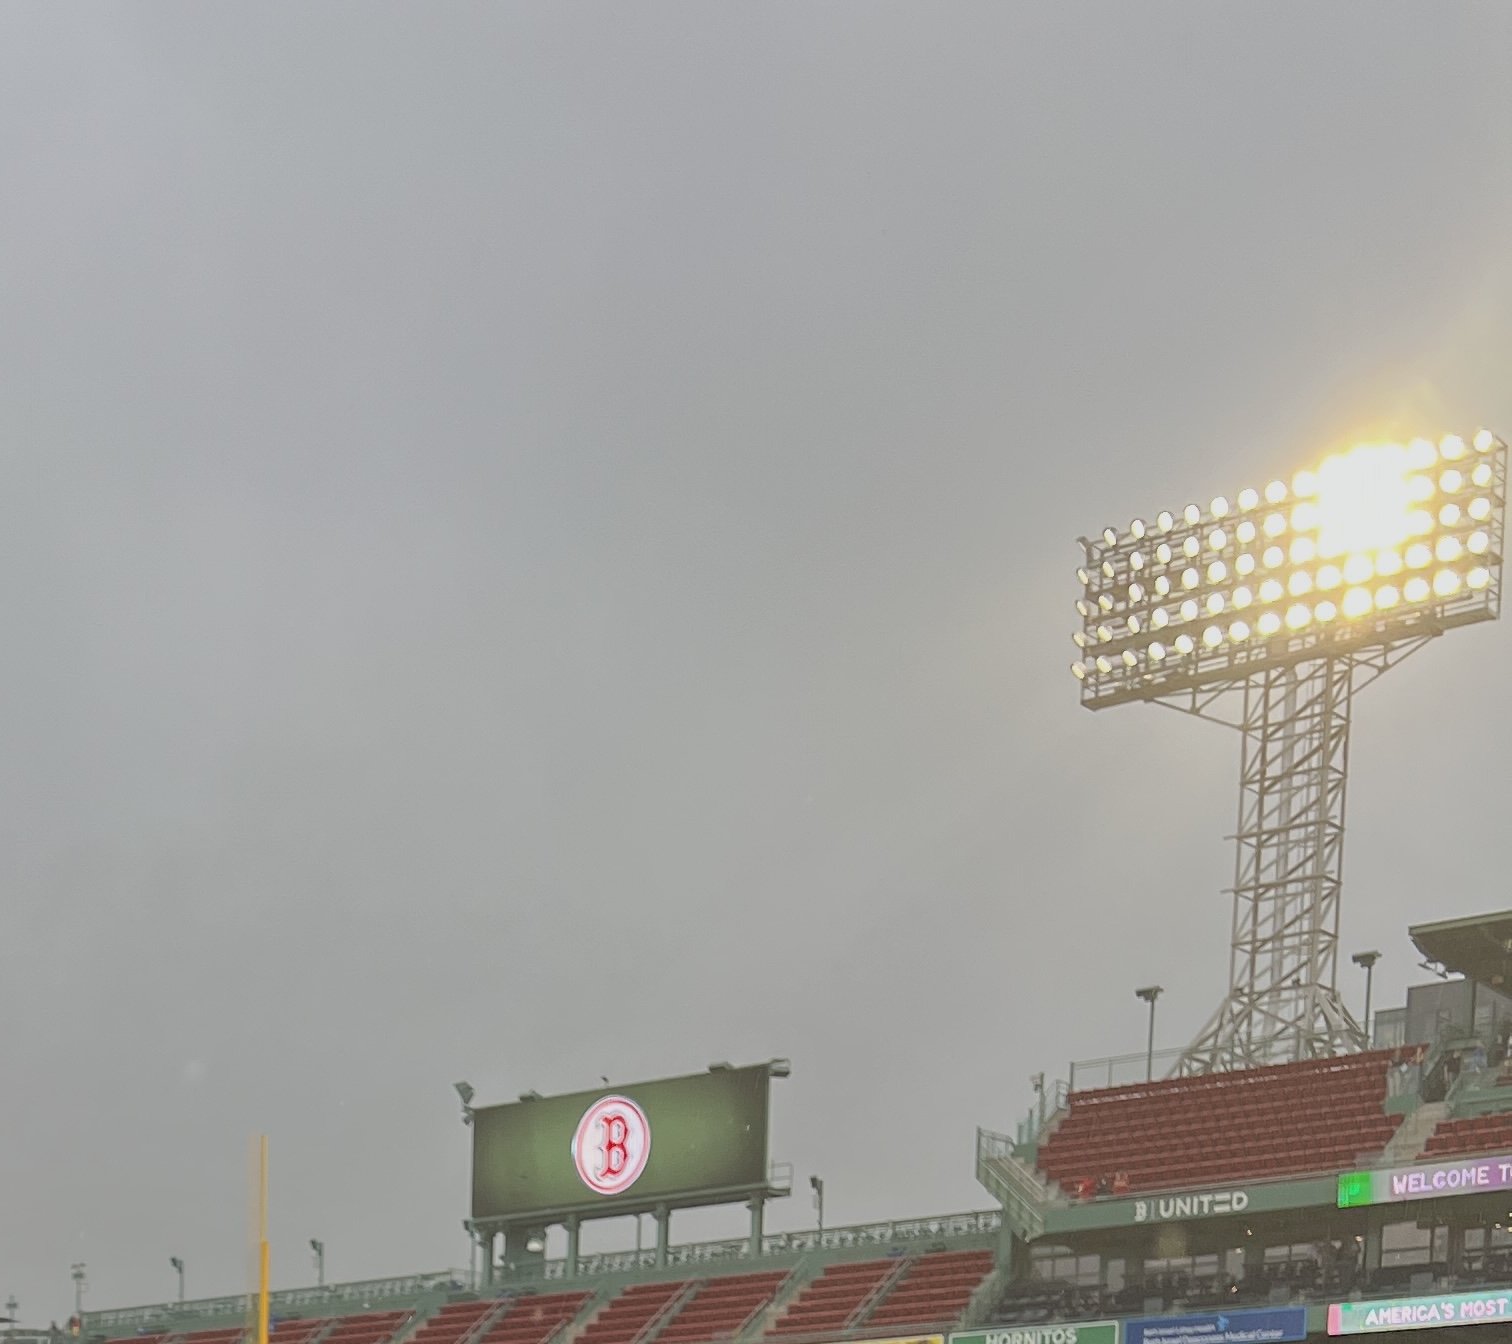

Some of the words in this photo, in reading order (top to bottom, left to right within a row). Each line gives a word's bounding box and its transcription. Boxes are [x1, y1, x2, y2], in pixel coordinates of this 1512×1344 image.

[595, 1111, 630, 1182] B
[1393, 1165, 1490, 1195] WELCOME
[1498, 1162, 1512, 1183] T
[1159, 1190, 1249, 1219] UNITED
[1365, 1301, 1455, 1327] AMERICA'S
[1460, 1298, 1509, 1319] MOST
